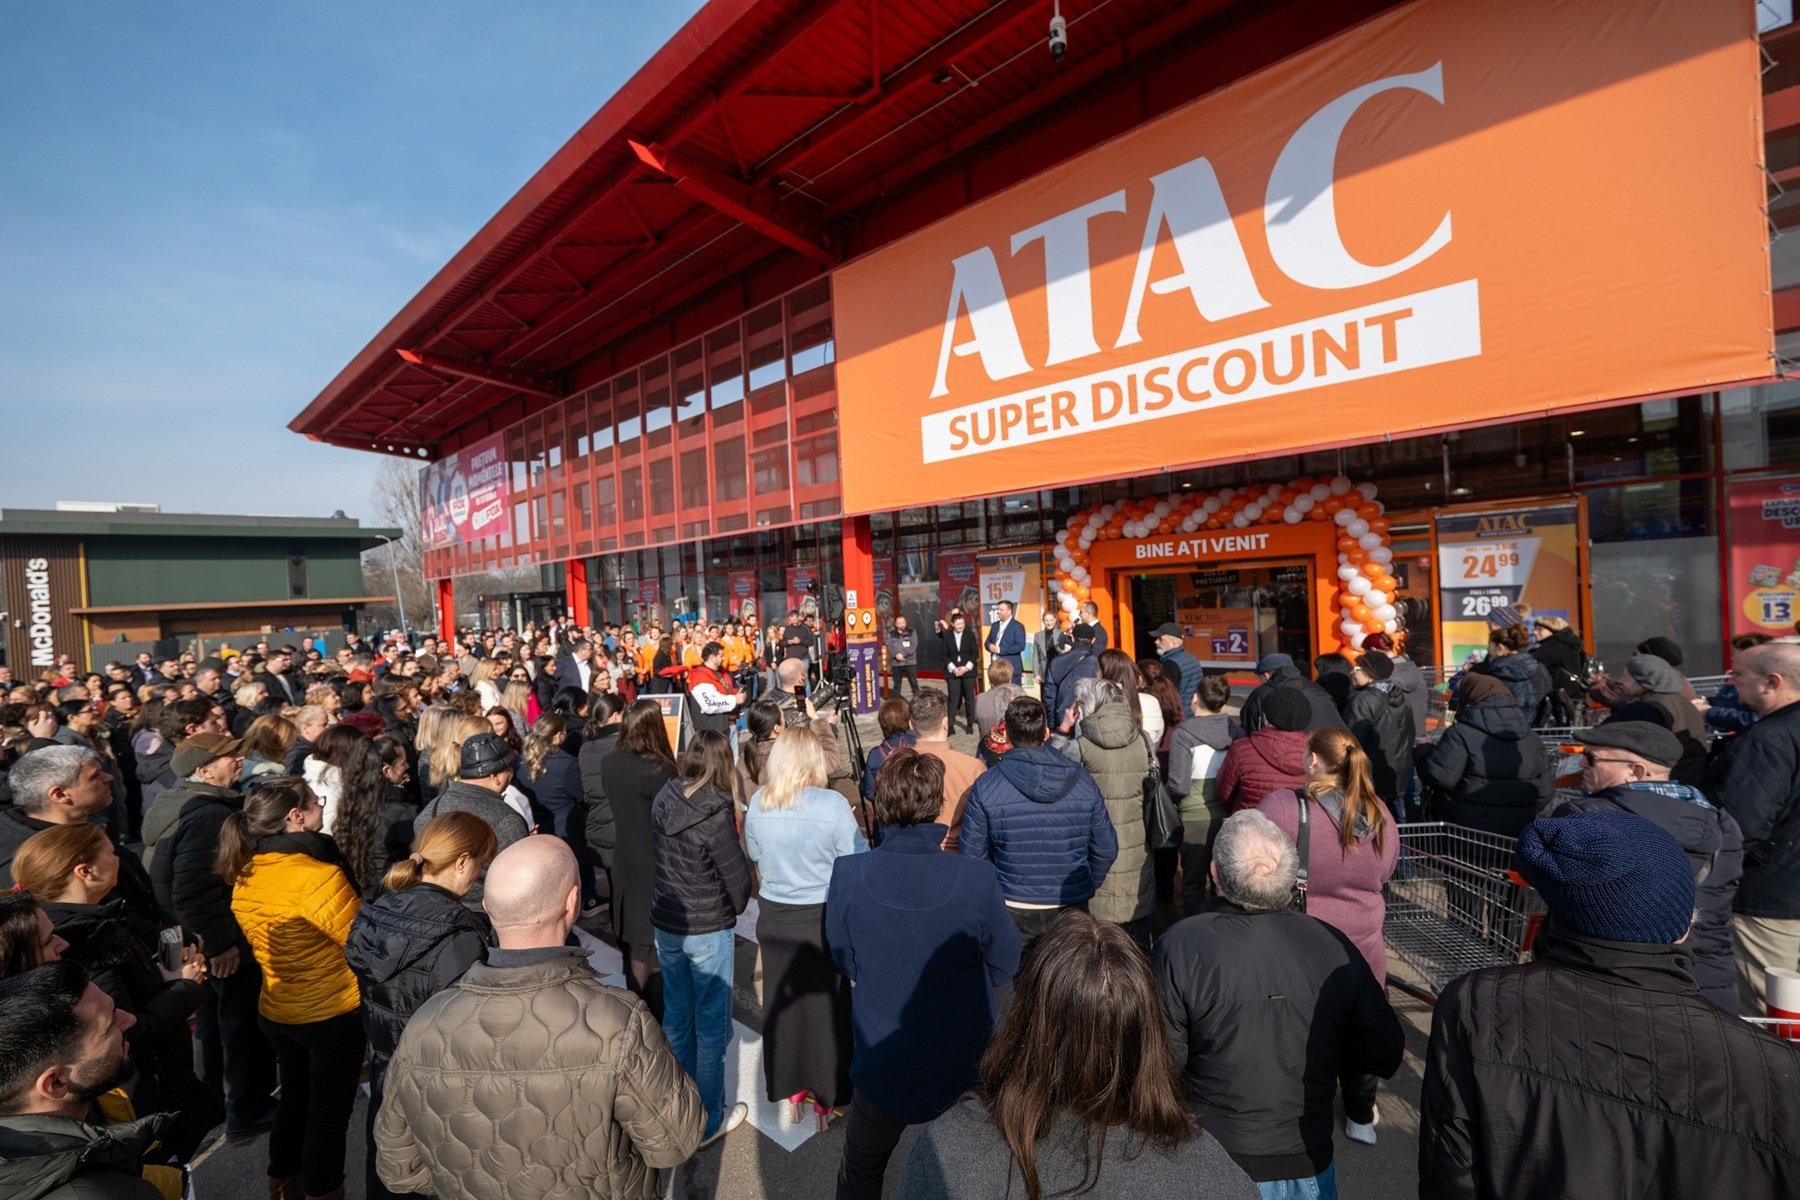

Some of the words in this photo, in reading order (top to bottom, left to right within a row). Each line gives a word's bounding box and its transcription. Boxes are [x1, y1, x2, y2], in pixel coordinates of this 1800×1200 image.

[930, 60, 1453, 399] ATAC
[948, 389, 1079, 452] SUPER
[1093, 307, 1413, 419] DISCOUNT
[453, 498, 465, 510] FOX
[1476, 513, 1534, 532] ATAC
[1136, 542, 1174, 559] BINE
[1177, 538, 1207, 559] AȚI
[1210, 533, 1270, 553] VENIT
[996, 556, 1022, 567] ATAC
[1462, 554, 1498, 580] 24
[986, 583, 1002, 600] 15
[26, 557, 54, 666] McDonald's
[1462, 597, 1491, 617] 26
[1491, 596, 1509, 608] 99
[1762, 602, 1791, 618] 13
[865, 681, 873, 708] PICK-UP
